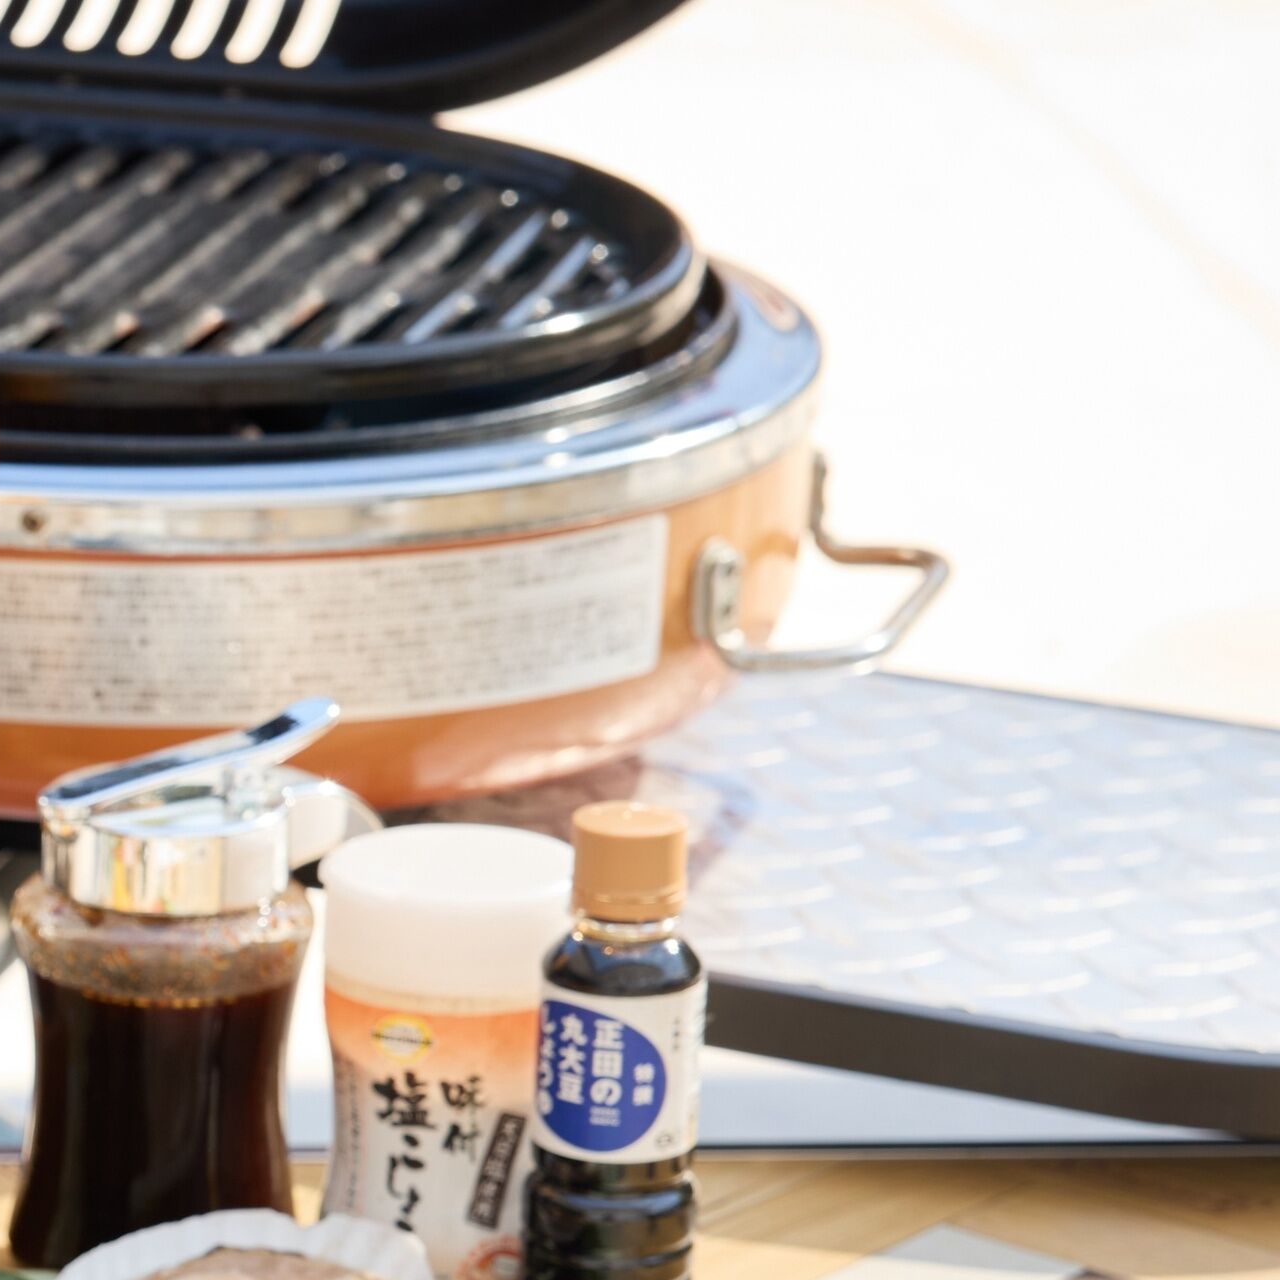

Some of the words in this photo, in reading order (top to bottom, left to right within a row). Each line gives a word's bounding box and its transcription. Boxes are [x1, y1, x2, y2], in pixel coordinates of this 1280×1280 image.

[556, 1012, 588, 1105] 丸大豆
[590, 1018, 624, 1107] 正田の
